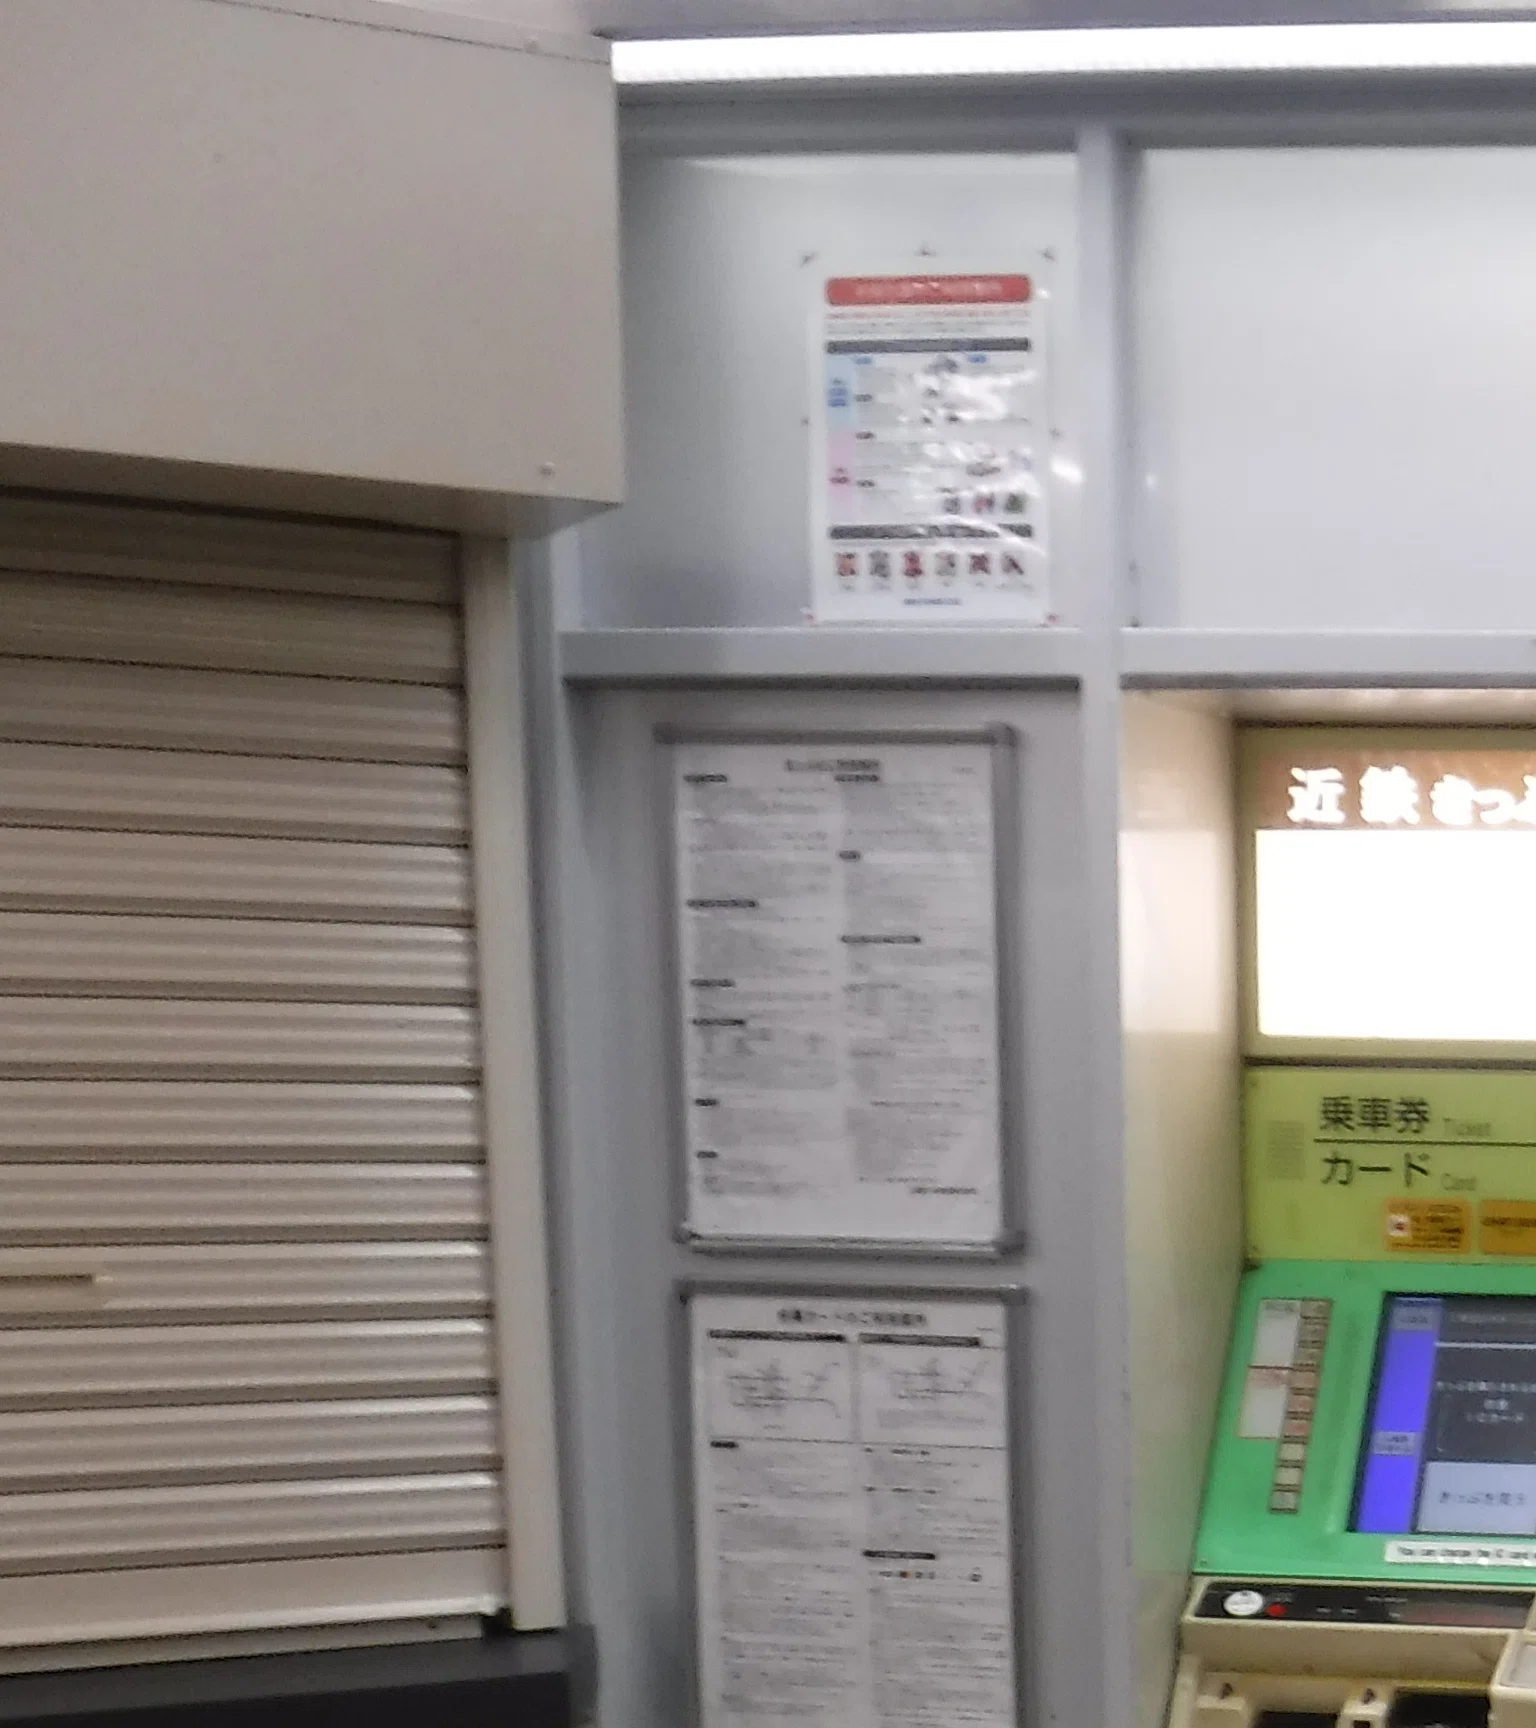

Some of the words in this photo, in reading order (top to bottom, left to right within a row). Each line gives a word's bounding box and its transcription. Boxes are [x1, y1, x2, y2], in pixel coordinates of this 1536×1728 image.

[1318, 1095, 1431, 1135] 乗車券
[1441, 1117, 1493, 1138] Ticket
[1320, 1151, 1431, 1187] カード
[1440, 1172, 1479, 1193] Card
